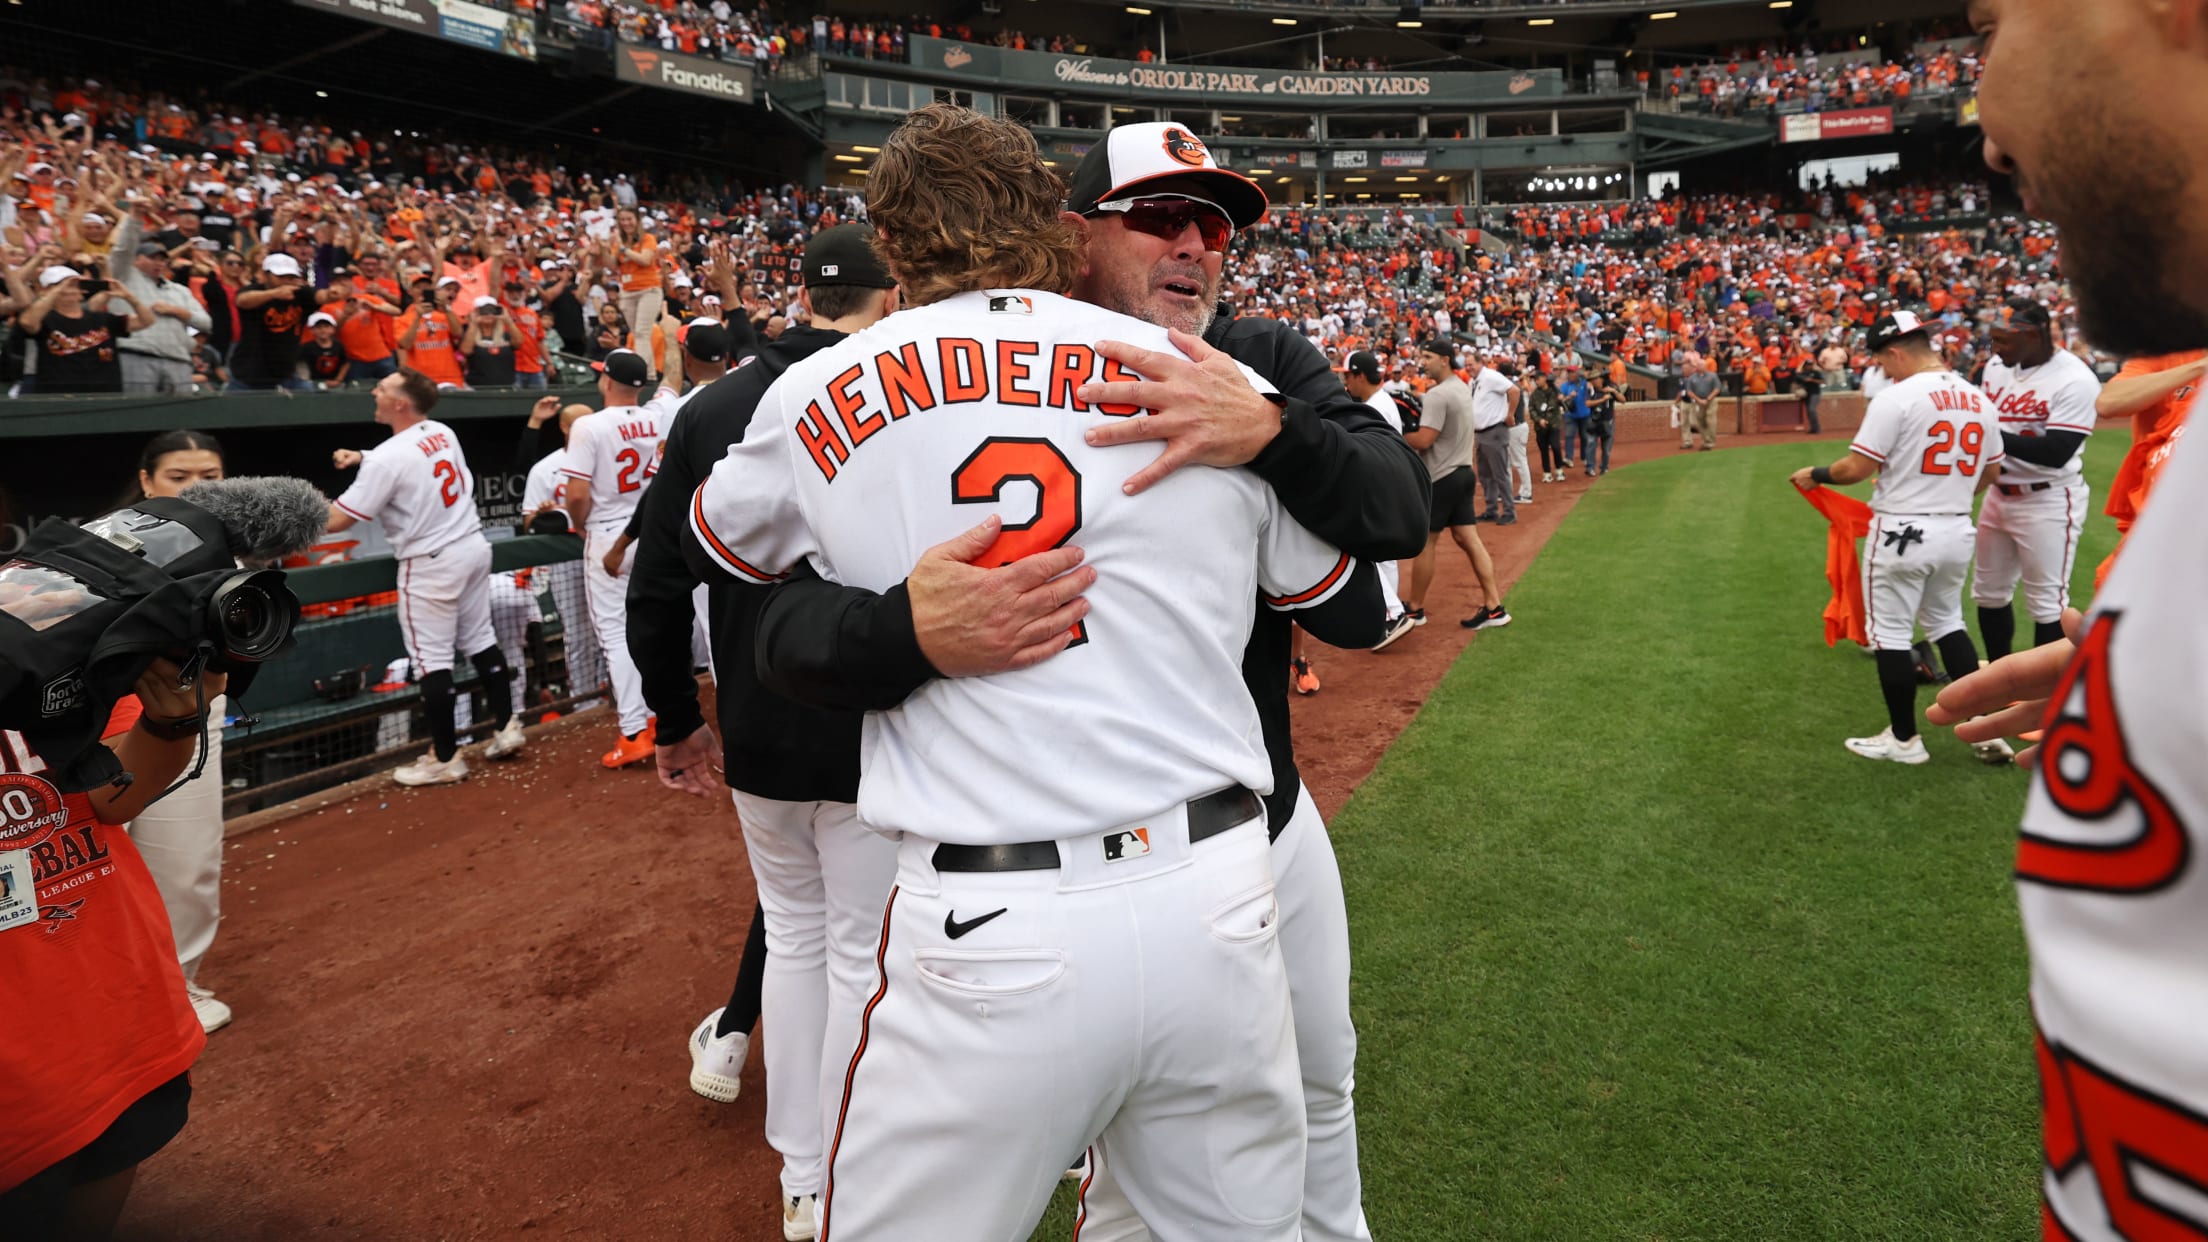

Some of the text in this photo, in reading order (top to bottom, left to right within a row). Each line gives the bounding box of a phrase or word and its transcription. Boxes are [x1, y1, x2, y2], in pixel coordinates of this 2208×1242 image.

[661, 60, 744, 96] Fanatics
[1055, 59, 1115, 85] Welcome
[1131, 67, 1205, 91] ORIOLE
[1207, 73, 1260, 93] PARK
[1279, 76, 1364, 95] CAMDEN
[1365, 77, 1430, 95] YARDS
[795, 337, 1162, 485] HENDERS
[618, 421, 659, 442] HALL
[1921, 420, 1984, 477] 29
[951, 436, 1090, 651] 2
[41, 871, 96, 899] LEAGUE
